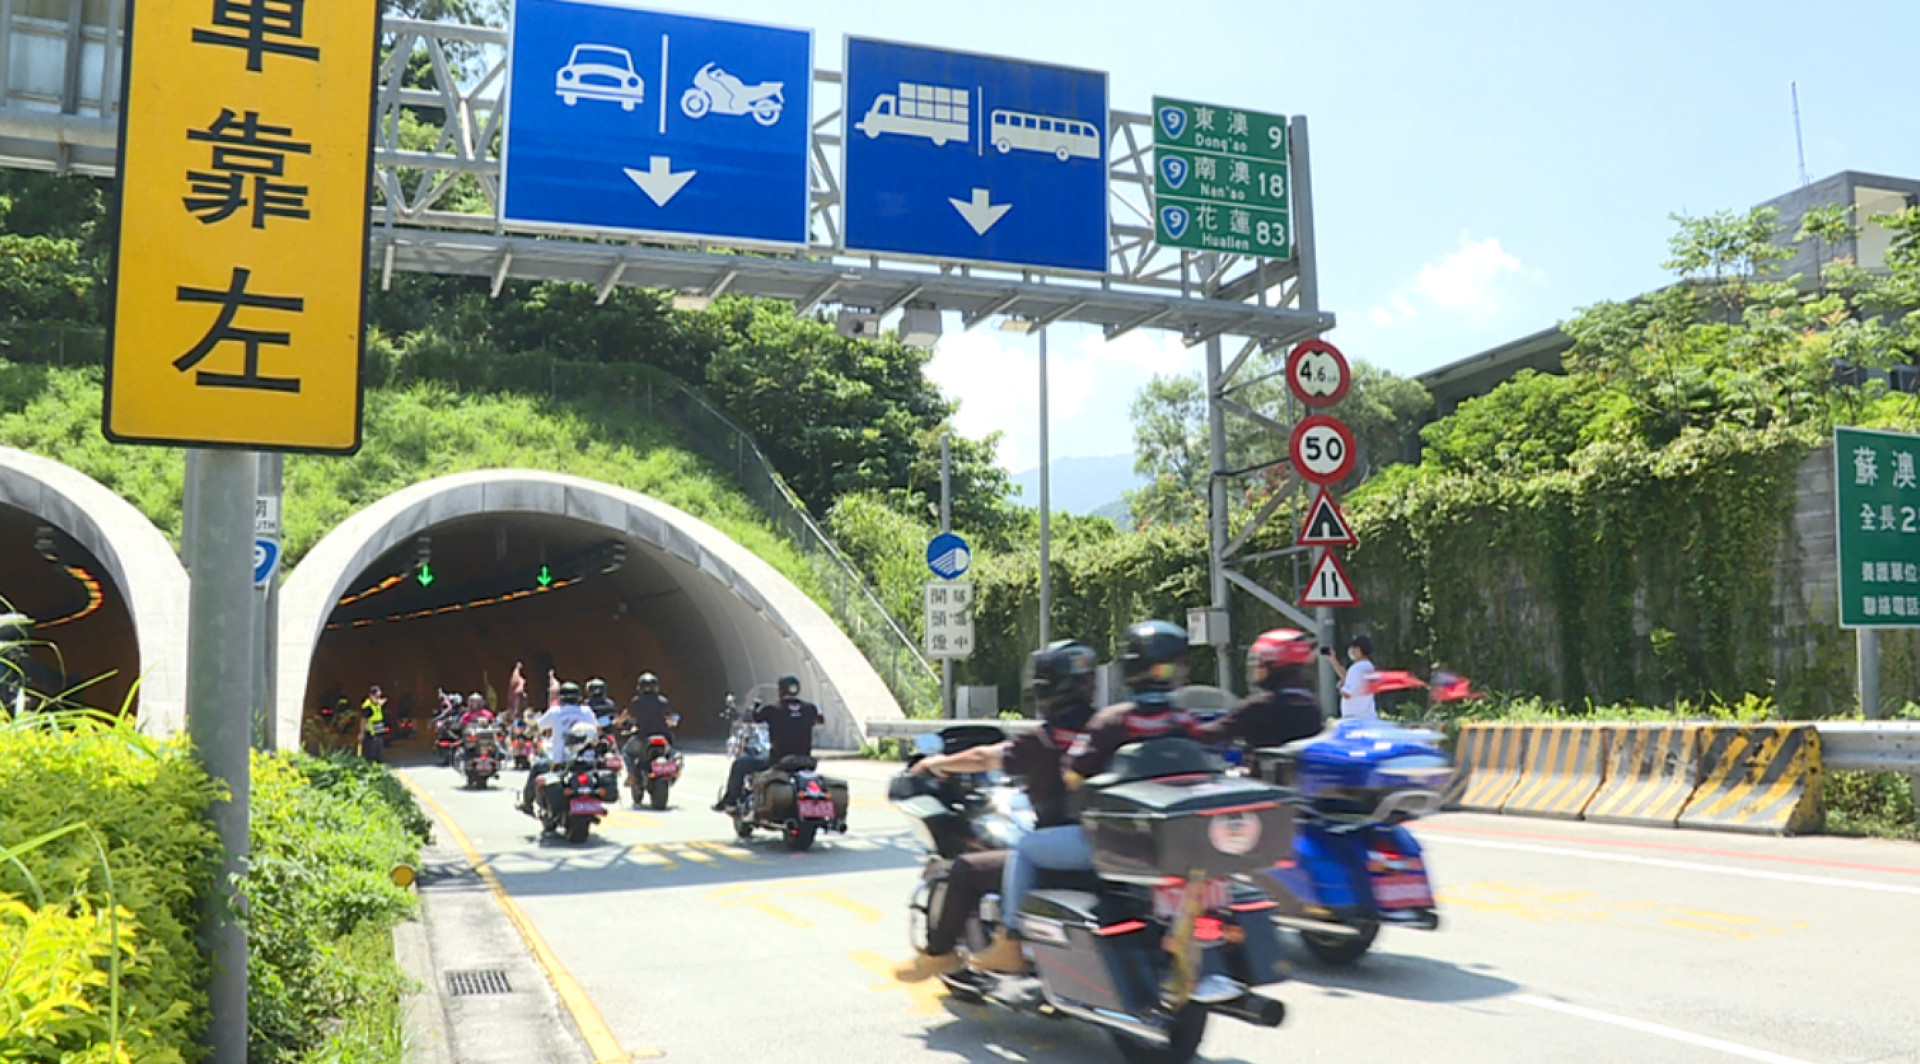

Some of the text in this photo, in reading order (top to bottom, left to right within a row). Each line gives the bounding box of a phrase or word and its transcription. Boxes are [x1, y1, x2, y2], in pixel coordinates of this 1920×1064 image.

[1167, 111, 1180, 129] 9
[1193, 105, 1248, 136] 東澳
[1268, 126, 1282, 149] 9
[1168, 162, 1181, 178] 9
[1194, 156, 1250, 185] 南澳
[172, 0, 320, 393] 車靠左
[1258, 172, 1284, 197] 18
[1169, 211, 1182, 229] 9
[1196, 203, 1251, 235] 花蓮
[1256, 220, 1285, 246] 83
[1305, 436, 1343, 461] 50
[1853, 446, 1917, 488] 蘇澳
[1859, 503, 1920, 533] 全長2
